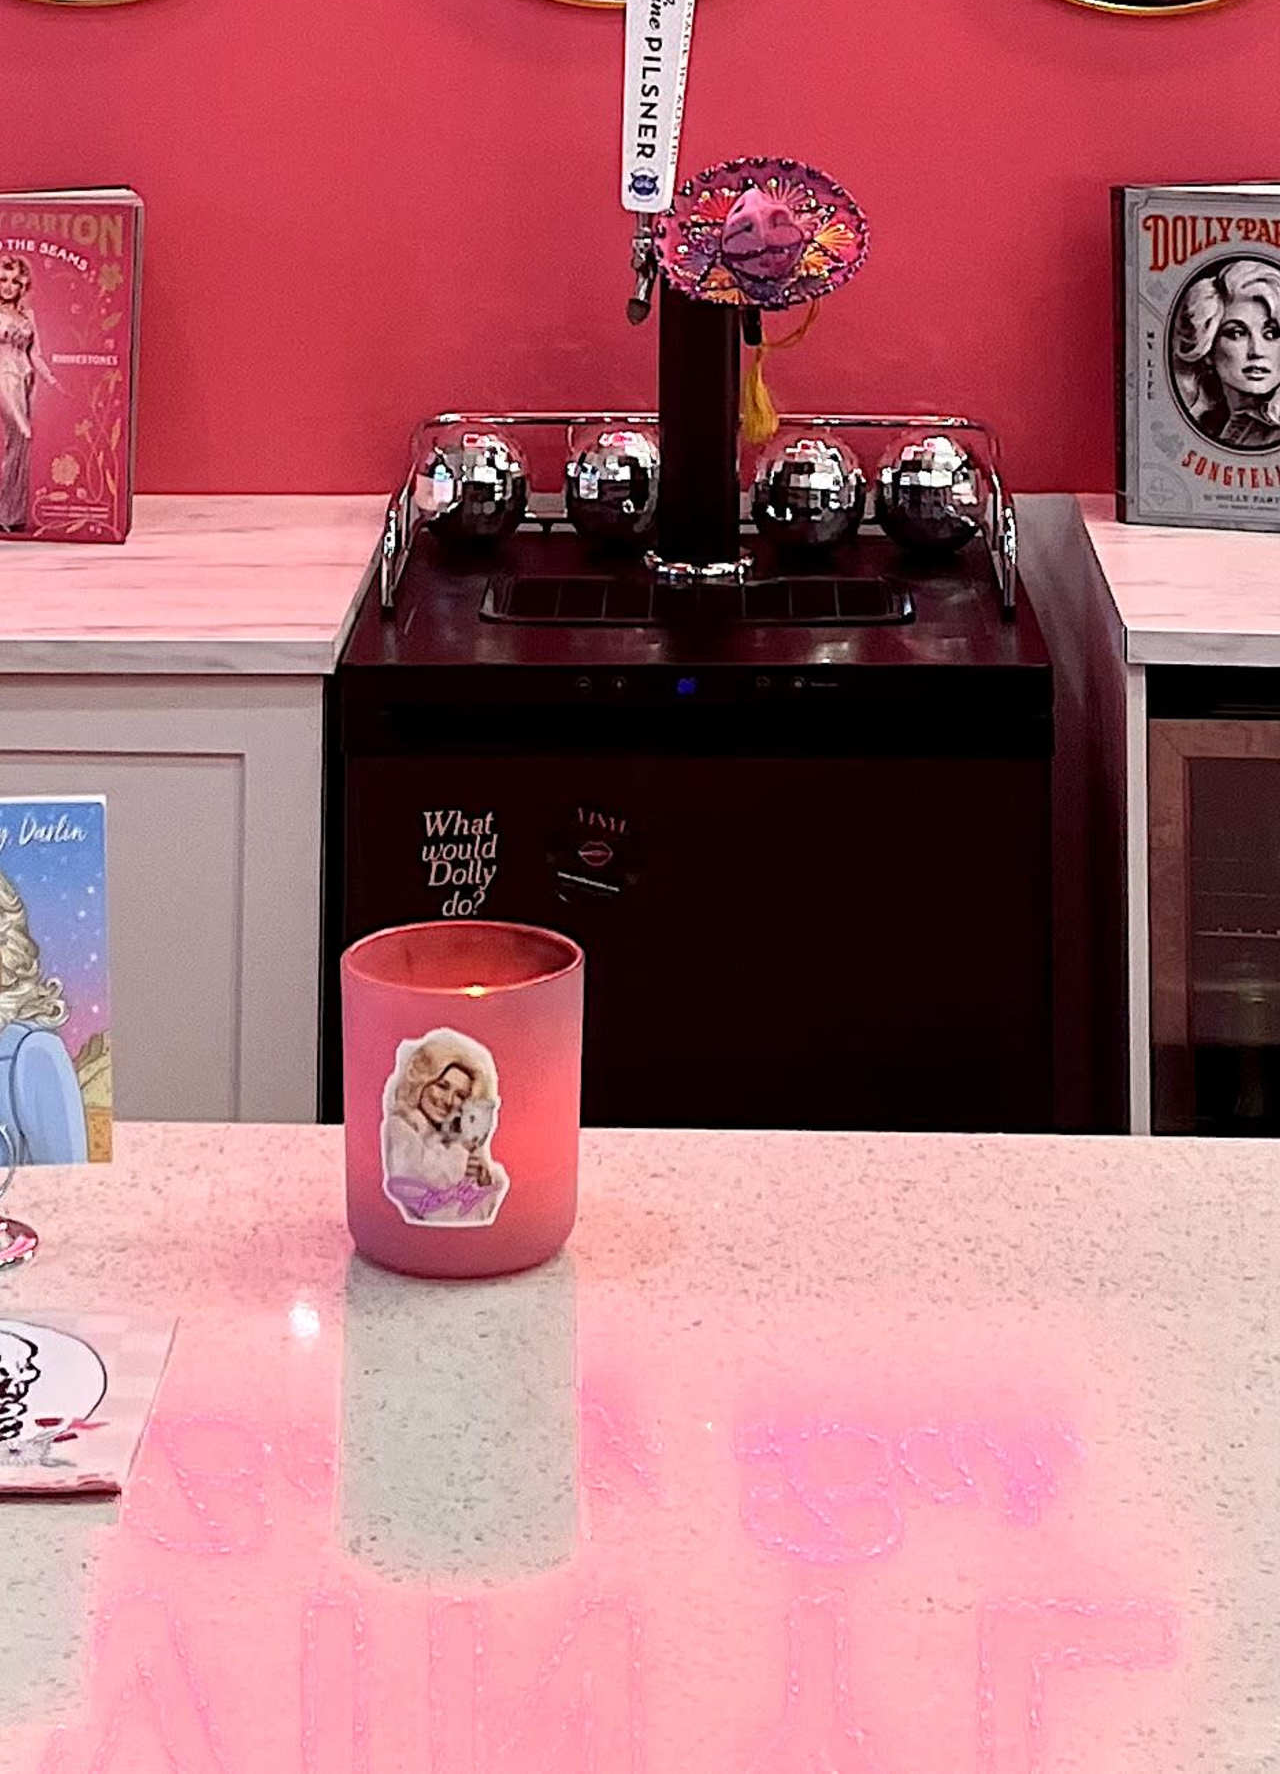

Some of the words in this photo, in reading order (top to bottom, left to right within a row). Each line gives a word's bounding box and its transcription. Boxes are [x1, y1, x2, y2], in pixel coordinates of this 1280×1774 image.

[635, 36, 663, 160] PILSNER
[11, 210, 124, 257] PARTON
[1142, 214, 1234, 272] DOLLY
[6, 238, 36, 252] THE
[39, 242, 89, 272] SEAMS
[18, 813, 89, 847] Darlin
[422, 810, 495, 838] What
[421, 834, 499, 863] would
[427, 860, 498, 892] Dolly
[441, 889, 486, 917] do?
